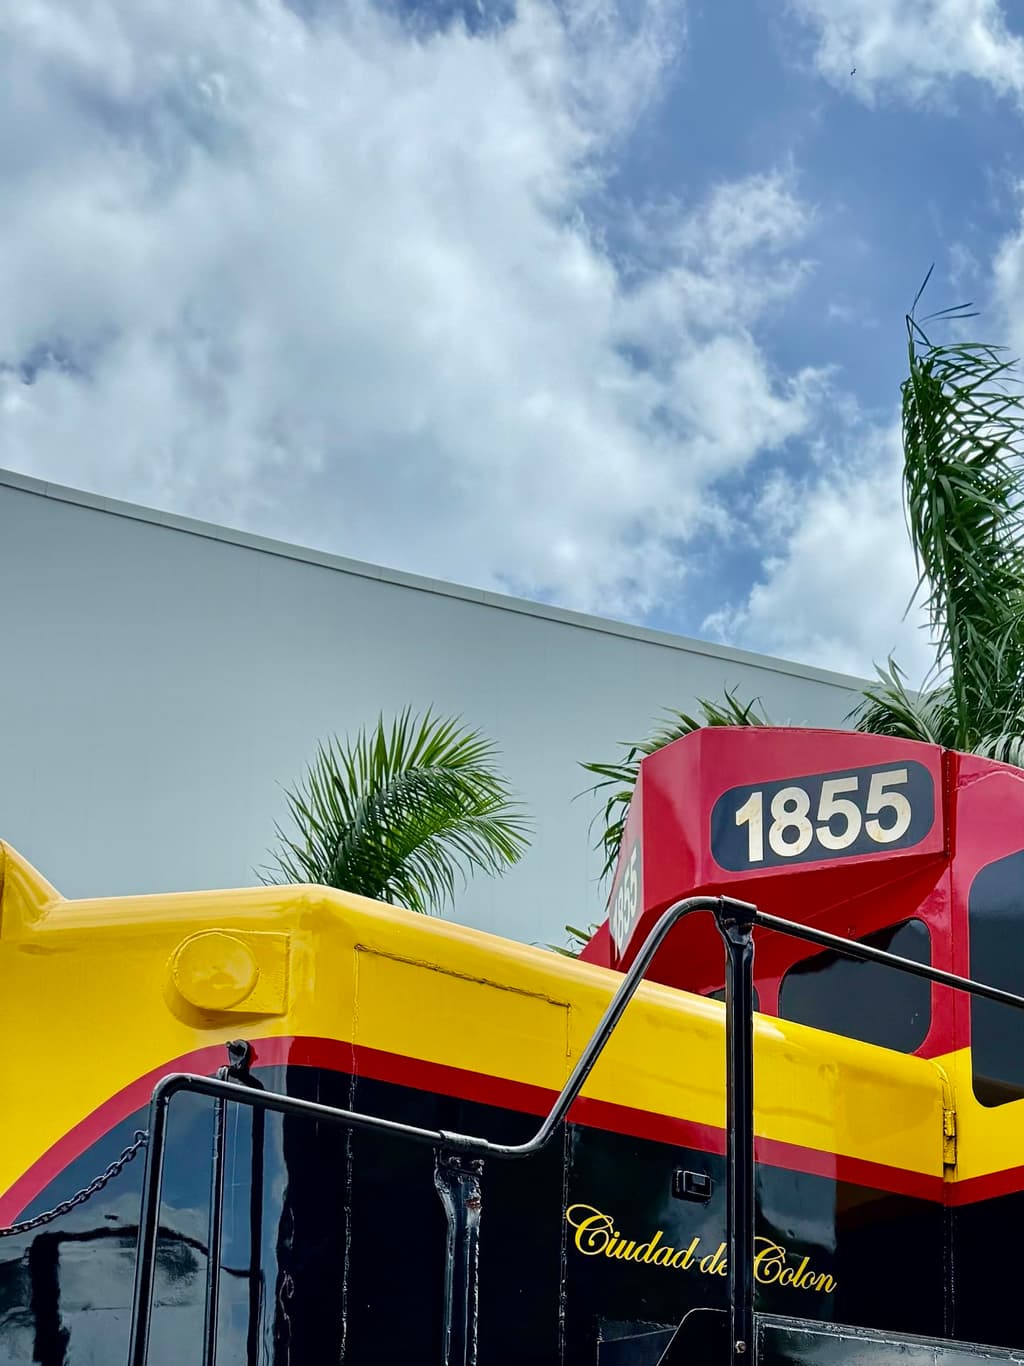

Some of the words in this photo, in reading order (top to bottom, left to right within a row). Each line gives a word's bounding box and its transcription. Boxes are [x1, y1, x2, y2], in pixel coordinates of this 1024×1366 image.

[735, 768, 912, 863] 1855
[566, 1204, 700, 1270] Ciudad
[700, 1242, 728, 1276] de
[753, 1236, 837, 1293] Colon
